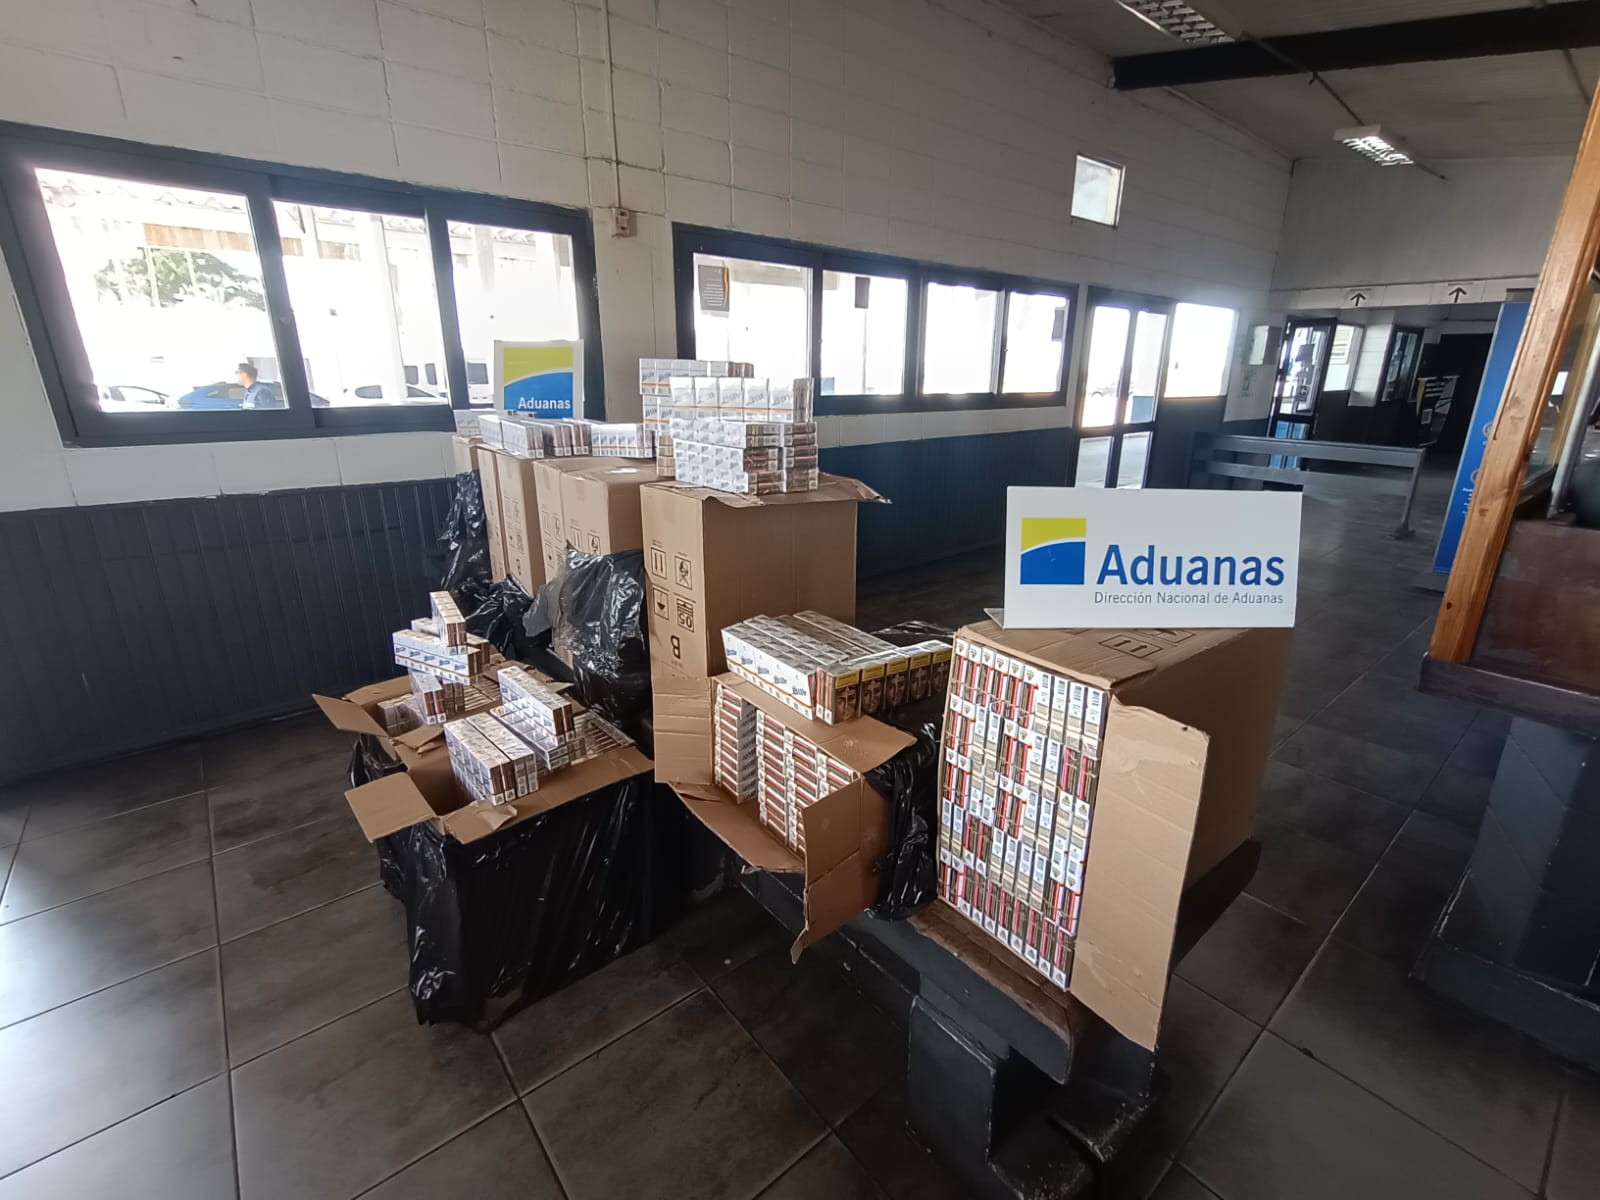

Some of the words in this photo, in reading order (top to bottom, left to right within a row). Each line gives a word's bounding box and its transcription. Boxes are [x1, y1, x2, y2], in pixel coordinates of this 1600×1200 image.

[518, 397, 571, 409] Aduanas
[1096, 544, 1285, 587] Aduanas
[1094, 591, 1152, 604] Dirección
[1156, 591, 1210, 604] Nacional
[1213, 591, 1229, 604] de
[1231, 591, 1284, 604] Aduanas
